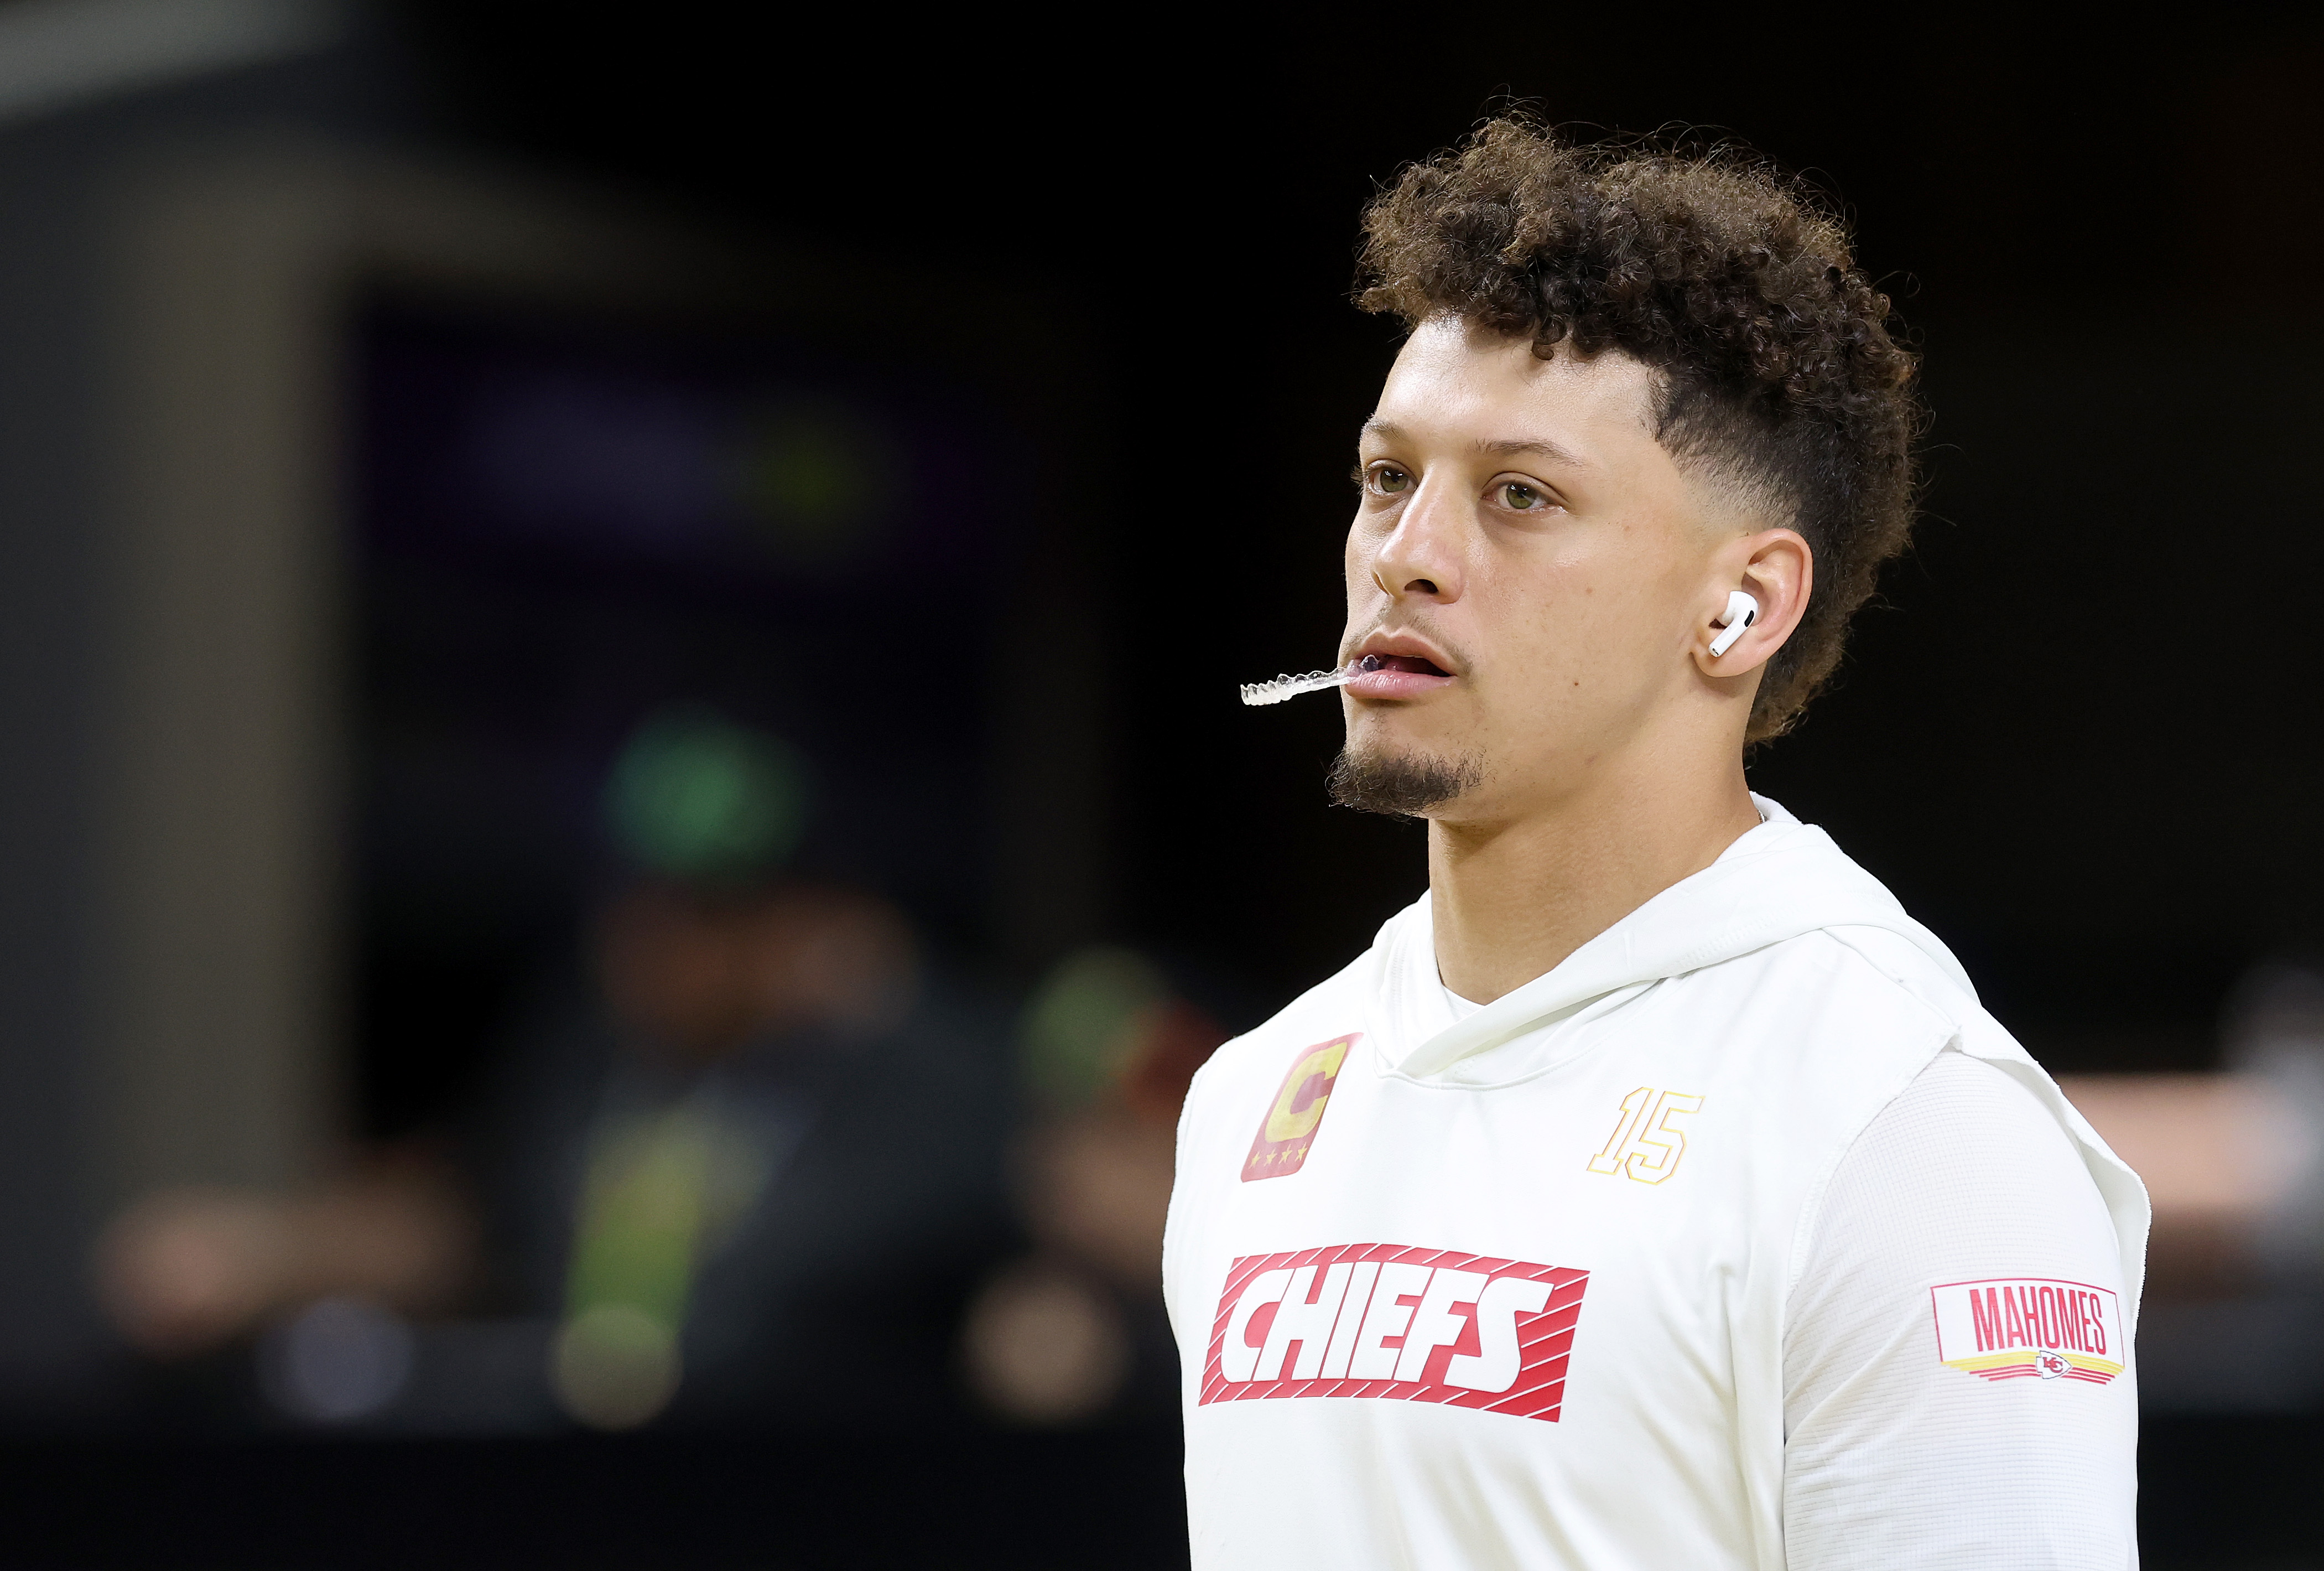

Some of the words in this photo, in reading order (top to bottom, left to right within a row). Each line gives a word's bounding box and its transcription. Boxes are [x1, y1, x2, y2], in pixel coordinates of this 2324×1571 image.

[1265, 1042, 1347, 1143] C
[1587, 1087, 1706, 1185] 15
[1221, 1262, 1554, 1393] CHIEFS
[1969, 1286, 2106, 1355] MAHOMES
